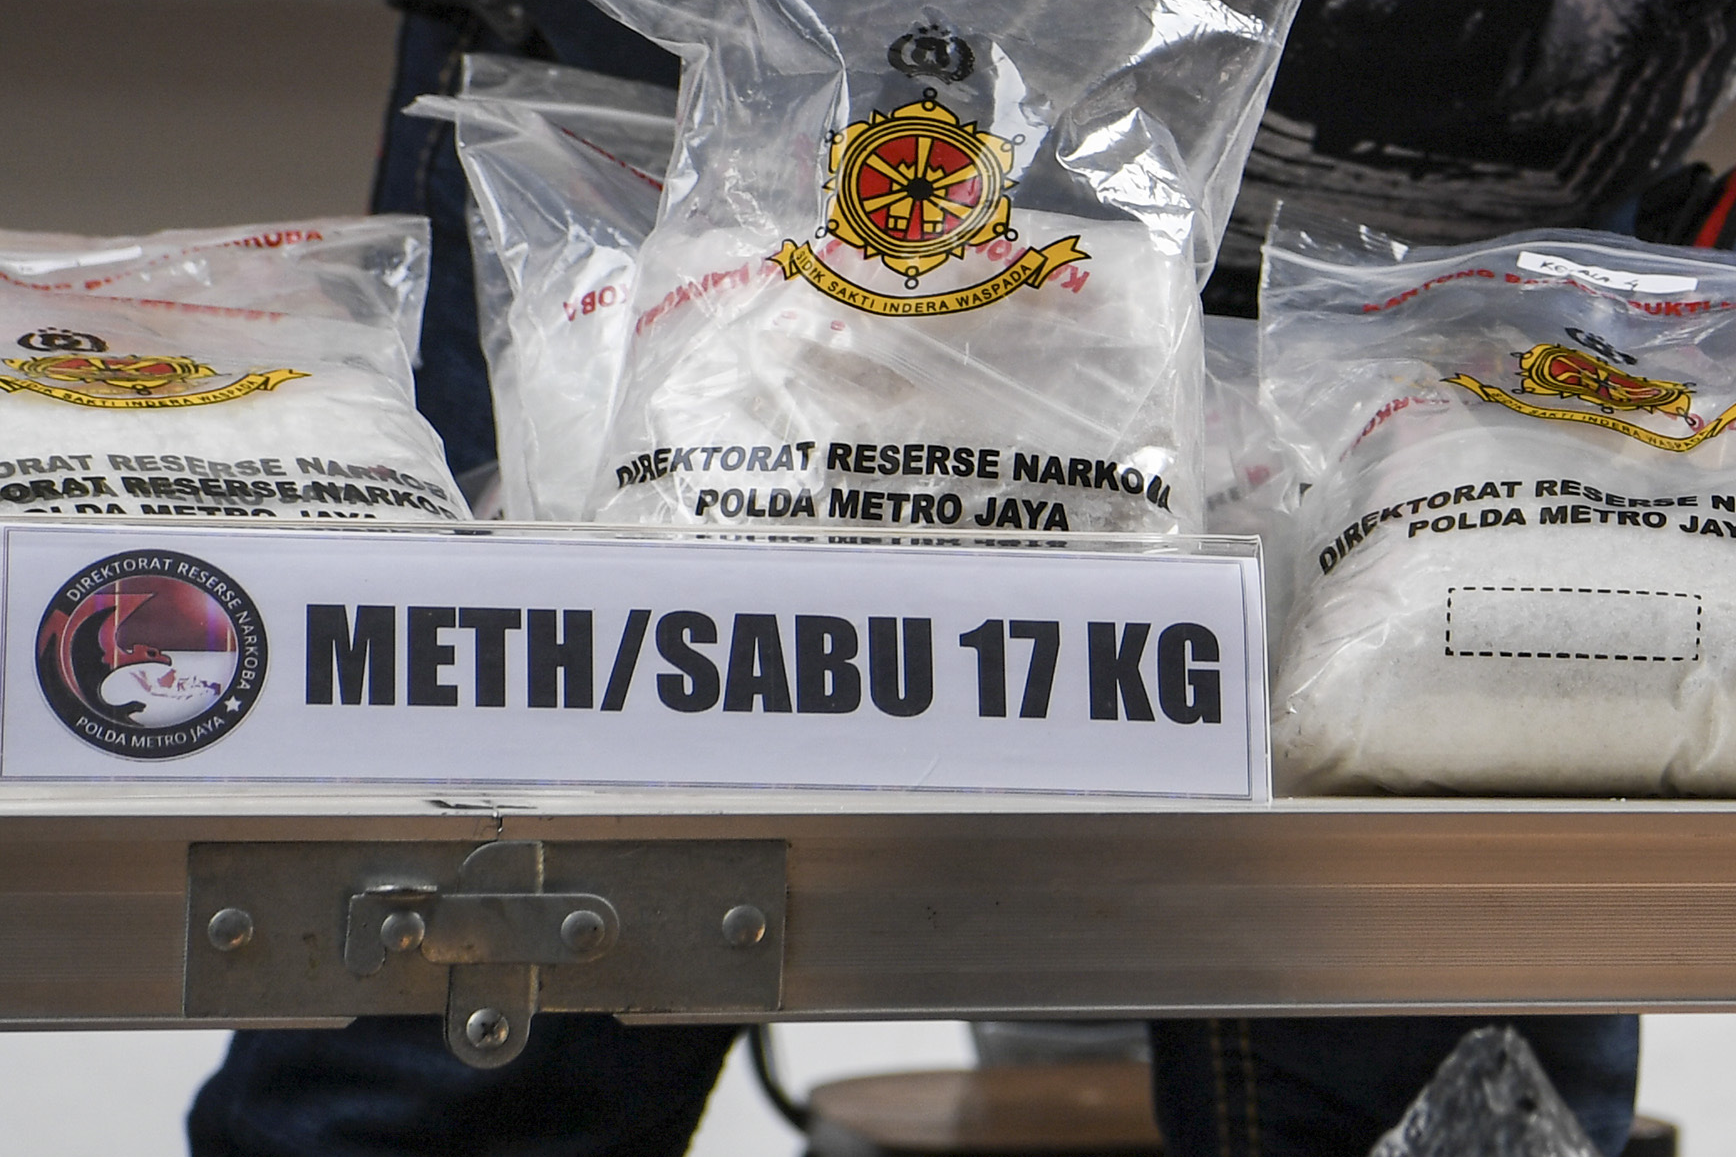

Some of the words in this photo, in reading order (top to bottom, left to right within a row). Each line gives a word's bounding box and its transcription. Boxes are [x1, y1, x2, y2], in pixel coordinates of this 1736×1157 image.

[828, 281, 875, 309] SAKTI
[882, 300, 950, 314] INDERA
[957, 262, 1033, 308] WASPADA
[106, 454, 287, 478] RESERSE
[120, 475, 300, 501] RESERSE
[615, 441, 816, 491] DIREKTORAT
[827, 442, 1001, 480] RESERSE
[694, 487, 816, 520] POLDA
[828, 488, 963, 526] METRO
[973, 496, 1070, 533] JAYA
[1318, 480, 1524, 576] DIREKTORAT
[1534, 479, 1700, 508] RESERSE
[1406, 507, 1528, 539] POLDA
[1538, 505, 1668, 529] METRO
[66, 557, 173, 602] DIREKTORAT
[176, 561, 243, 611] RESERSE
[234, 609, 260, 692] NARKOBA
[305, 603, 934, 718] METH/SABU
[958, 618, 1062, 721] 17
[1085, 620, 1223, 726] KG
[75, 715, 127, 747] POLDA
[130, 731, 188, 749] METRO
[189, 714, 226, 742] JAYA
